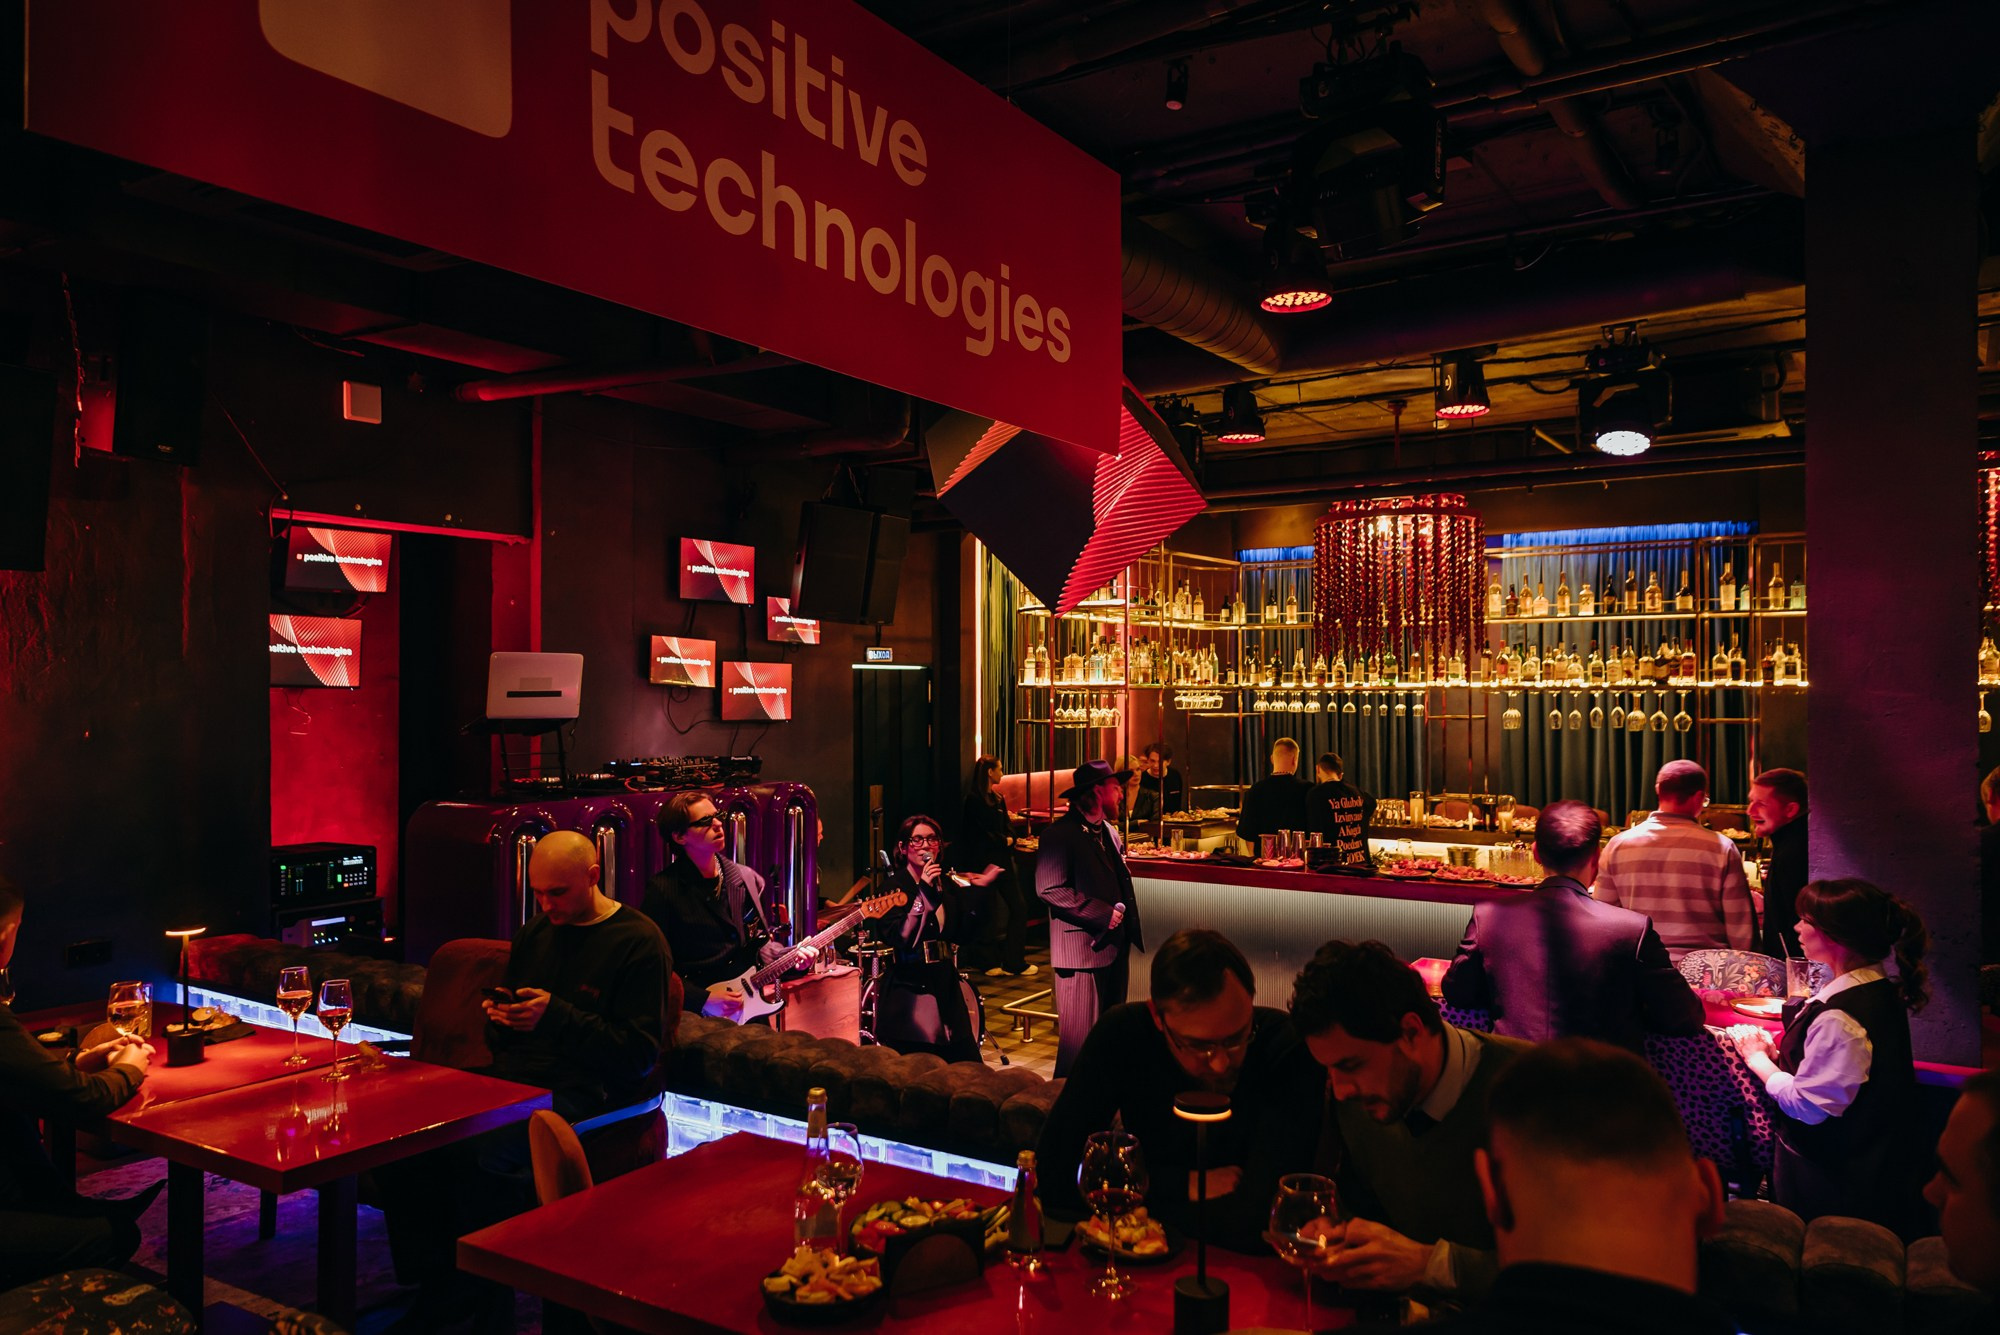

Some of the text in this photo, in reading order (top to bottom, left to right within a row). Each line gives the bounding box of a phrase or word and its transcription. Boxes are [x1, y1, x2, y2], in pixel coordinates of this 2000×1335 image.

[590, 0, 928, 187] positive
[591, 68, 1072, 363] technologies
[304, 553, 382, 566] positive technologies
[692, 565, 749, 578] positive technologies
[269, 643, 352, 657] sitive technologies
[661, 656, 711, 666] positive technologies
[733, 686, 787, 695] positive technologies
